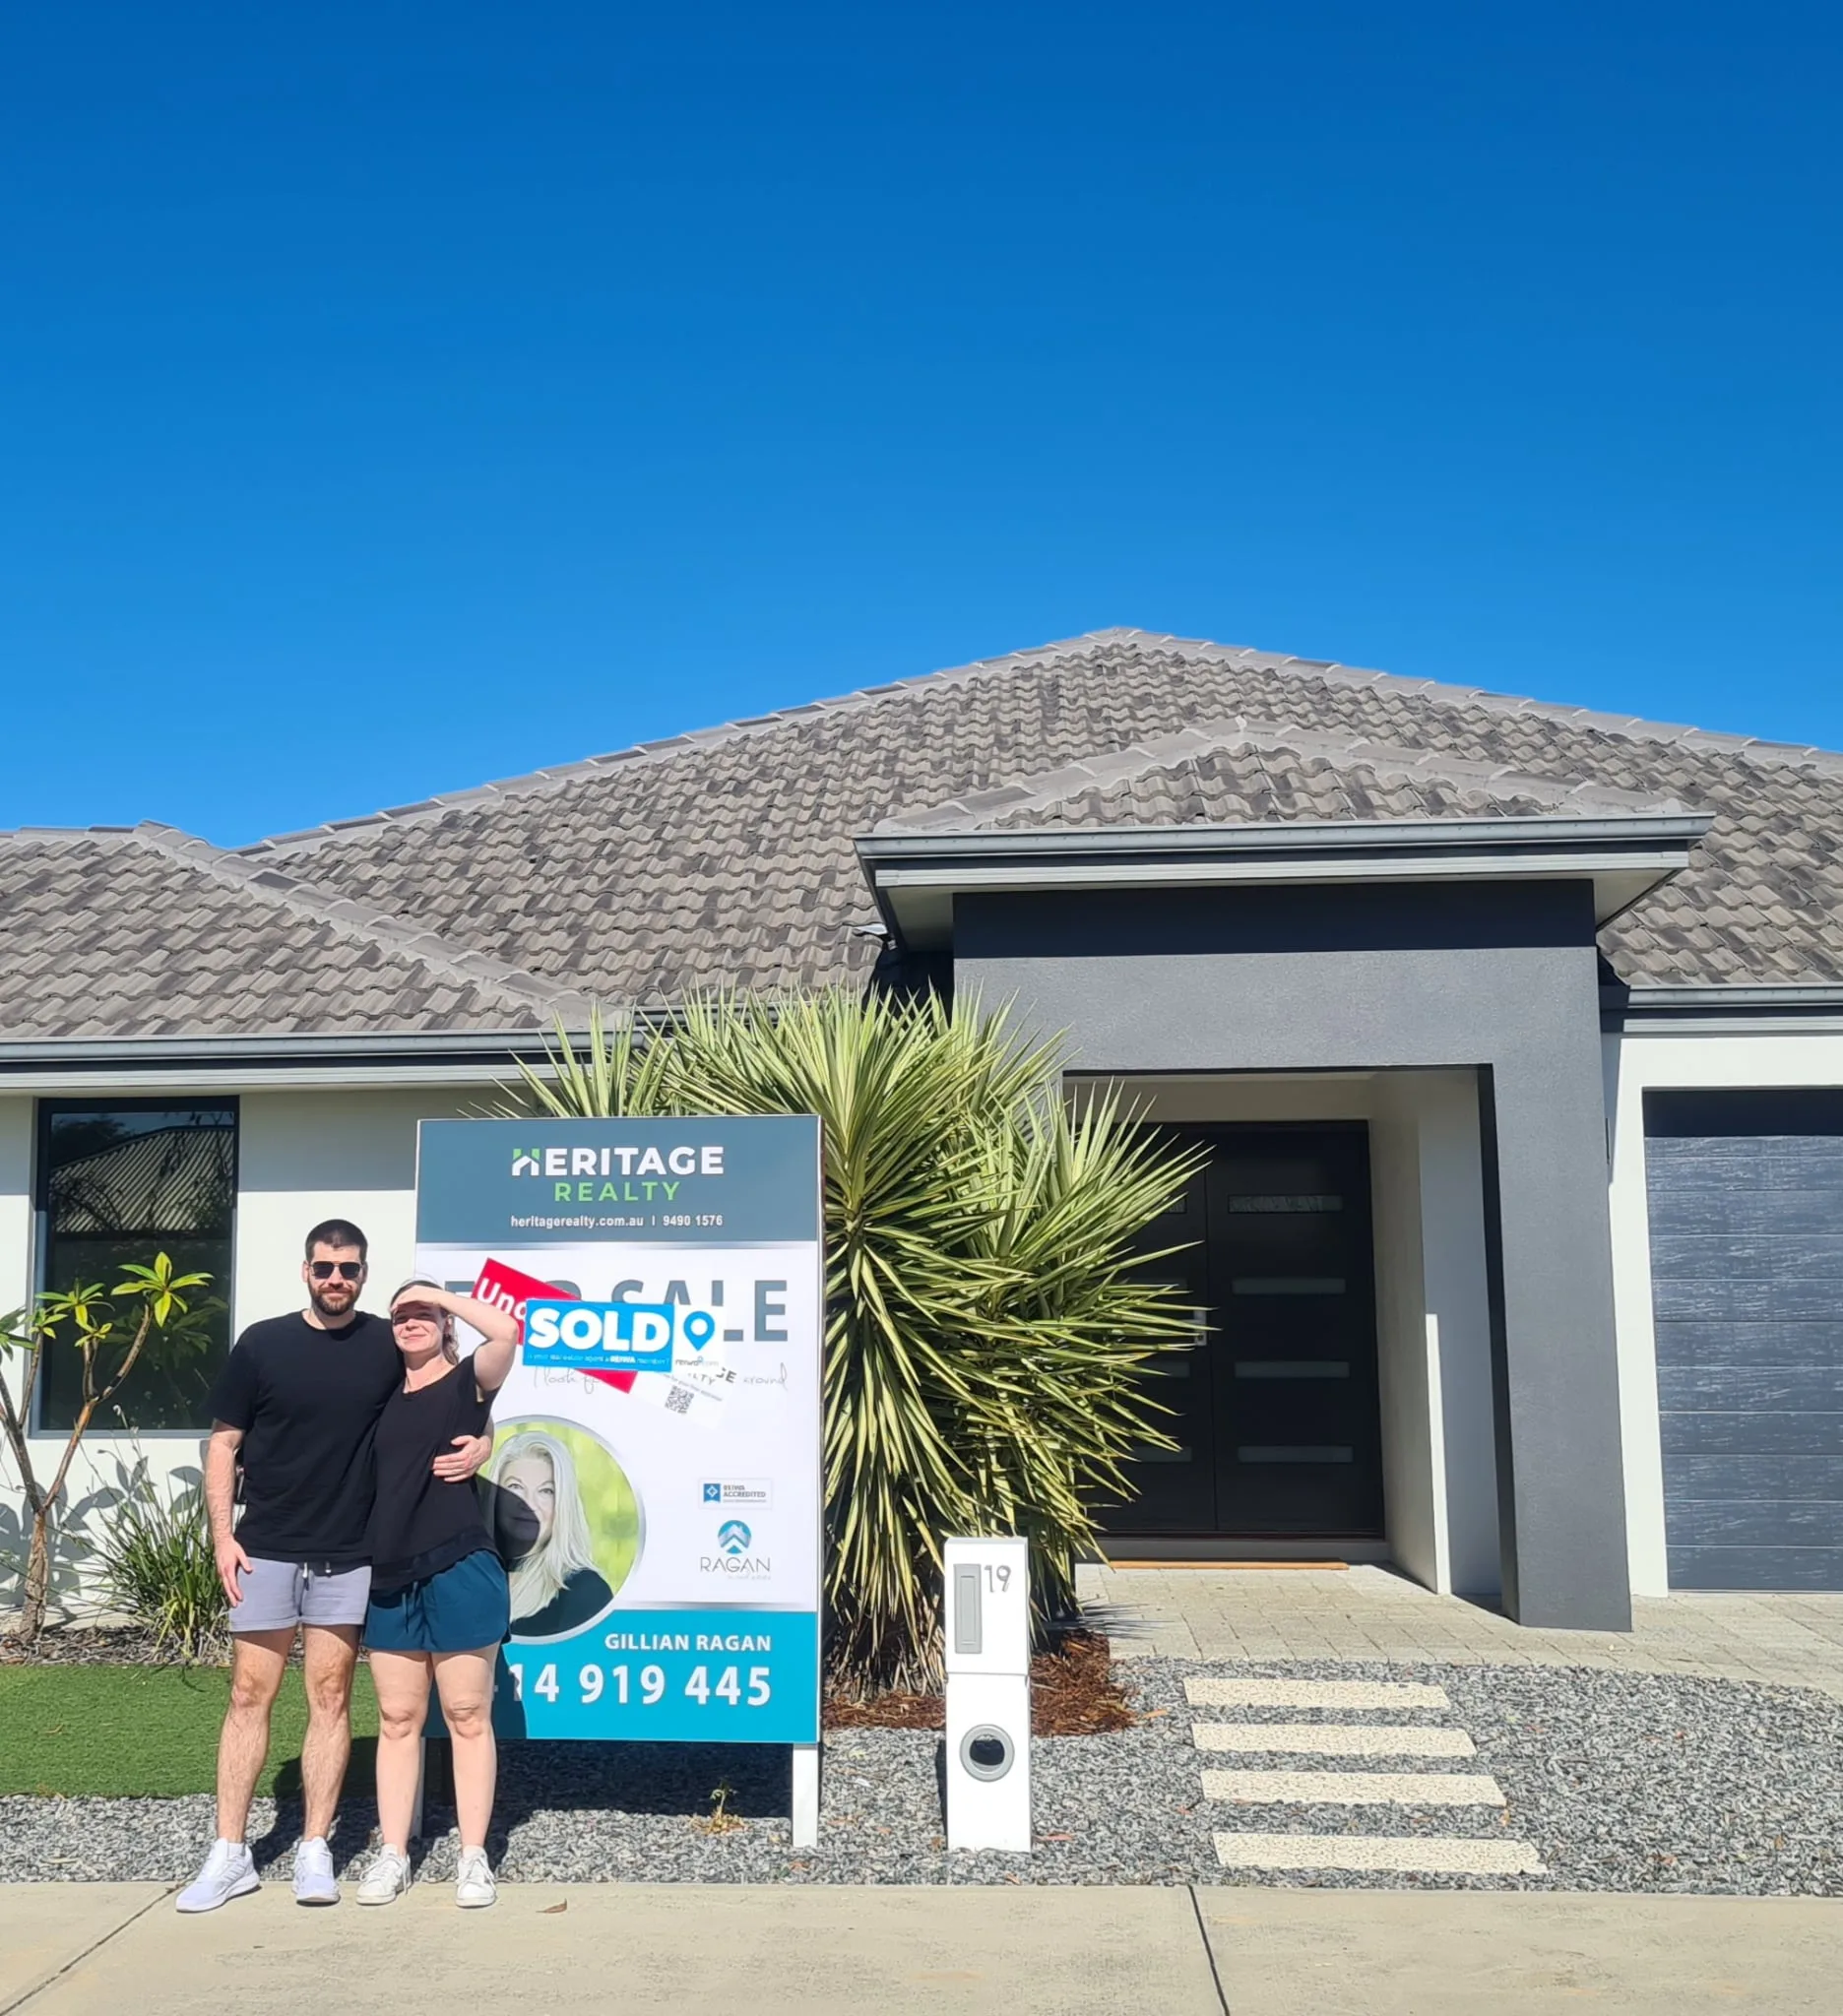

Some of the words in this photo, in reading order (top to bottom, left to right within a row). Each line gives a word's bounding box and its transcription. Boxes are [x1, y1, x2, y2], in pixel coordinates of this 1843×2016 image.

[511, 1146, 725, 1176] HERITAGE
[554, 1181, 680, 1202] REALTY
[510, 1215, 644, 1229] heritagerealty.com.au
[663, 1215, 691, 1227] 9490
[695, 1215, 723, 1227] 1576
[527, 1307, 671, 1353] SOLD
[700, 1557, 770, 1573] RAGAN
[984, 1564, 1012, 1593] 19
[604, 1633, 689, 1650] GILLIAN
[696, 1635, 772, 1652] RAGAN
[579, 1663, 666, 1705] 919
[684, 1666, 772, 1707] 445
